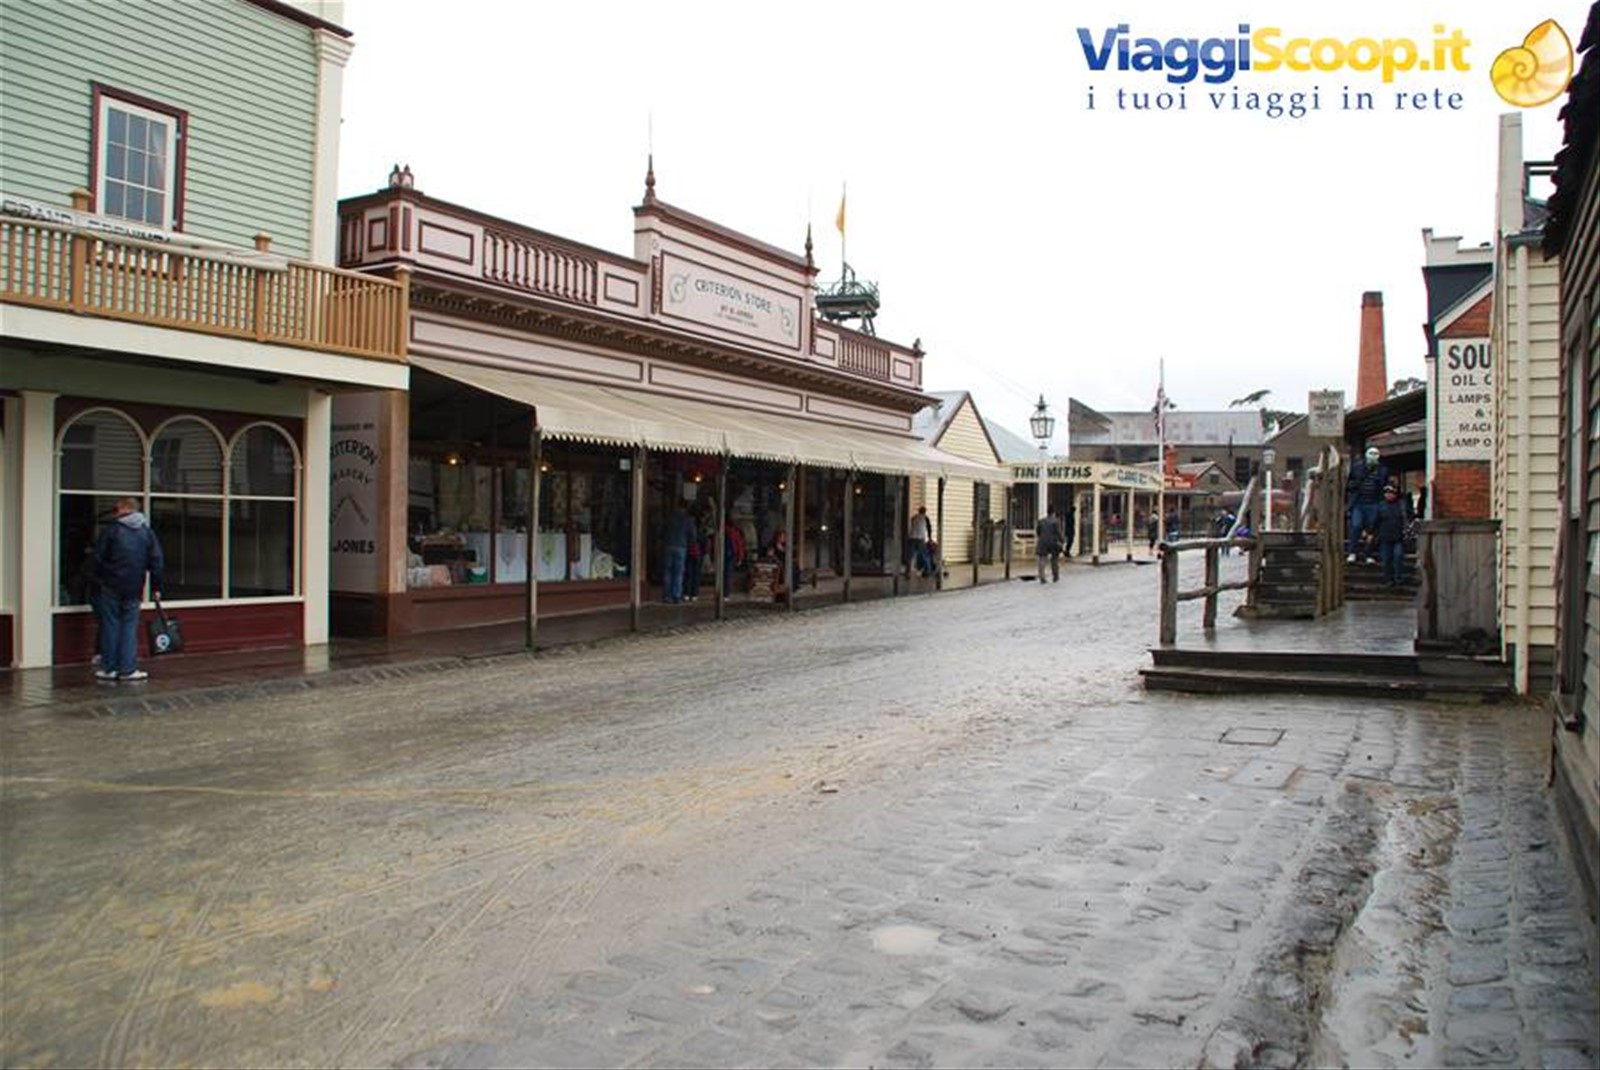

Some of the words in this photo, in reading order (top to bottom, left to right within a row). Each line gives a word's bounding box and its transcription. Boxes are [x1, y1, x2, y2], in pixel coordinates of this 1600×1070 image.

[694, 279, 742, 301] CRITERION
[744, 292, 771, 314] STORE
[1448, 343, 1492, 370] SOU
[1451, 374, 1478, 386] OIL
[1449, 393, 1492, 404] LAMPS
[331, 439, 378, 465] ITERION
[1446, 438, 1480, 448] LAMP
[1483, 438, 1492, 448] O
